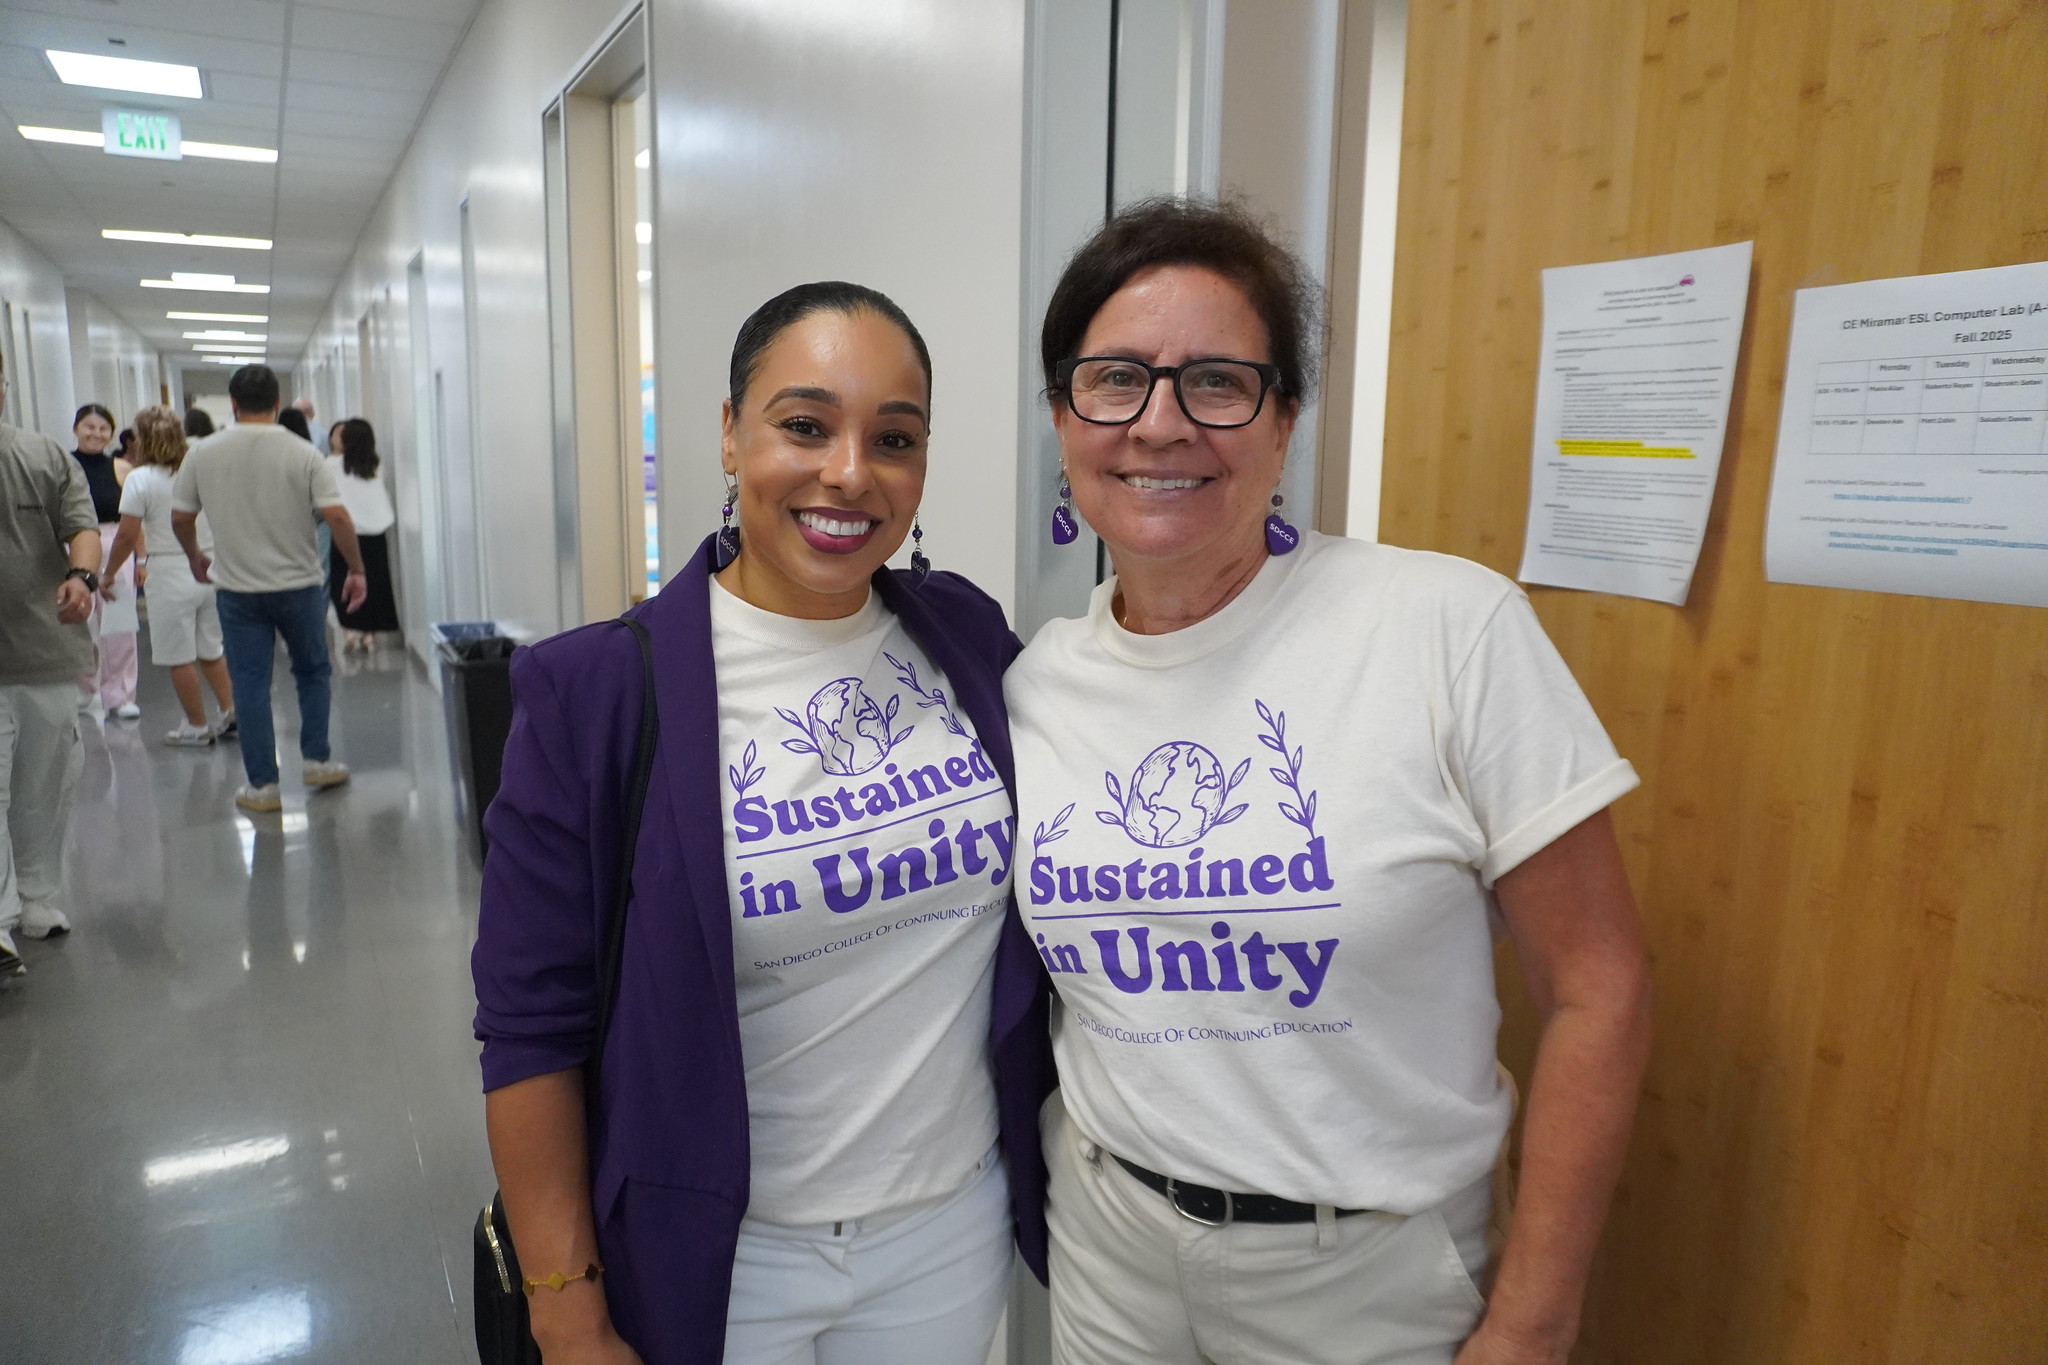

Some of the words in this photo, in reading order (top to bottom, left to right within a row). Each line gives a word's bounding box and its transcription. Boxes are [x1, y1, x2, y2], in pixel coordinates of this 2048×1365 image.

[117, 112, 168, 151] EXIT
[1843, 319, 1858, 330] CE
[1860, 315, 1906, 328] Miramar
[1909, 313, 1931, 324] ESL
[1934, 307, 1997, 322] Computer
[2000, 304, 2025, 316] Lab
[2029, 302, 2048, 316] (A-
[1954, 332, 1977, 343] Fall
[1980, 329, 2013, 342] 2025
[1879, 363, 1912, 372] Monday
[1935, 360, 1971, 370] Tuesday
[1991, 355, 2047, 366] Wednesday
[1055, 510, 1073, 537] SDCCE
[1269, 522, 1295, 545] SDCCE
[720, 536, 737, 556] SDCCE
[733, 739, 996, 844] Sustained
[739, 871, 801, 918] in
[812, 815, 1014, 913] Unity
[1030, 836, 1334, 905] Sustained
[754, 958, 780, 970] SAN
[782, 948, 822, 966] DIEGO
[824, 930, 874, 953] COLLEGE
[875, 925, 892, 936] OF
[895, 907, 970, 930] CONTINUING
[1036, 933, 1088, 974] in
[1090, 921, 1340, 1009] Unity
[1115, 1028, 1162, 1044] COLLEGE
[1164, 1028, 1184, 1042] OF
[1188, 1026, 1271, 1042] CONTINUING
[1273, 1017, 1353, 1036] EDUCATION
